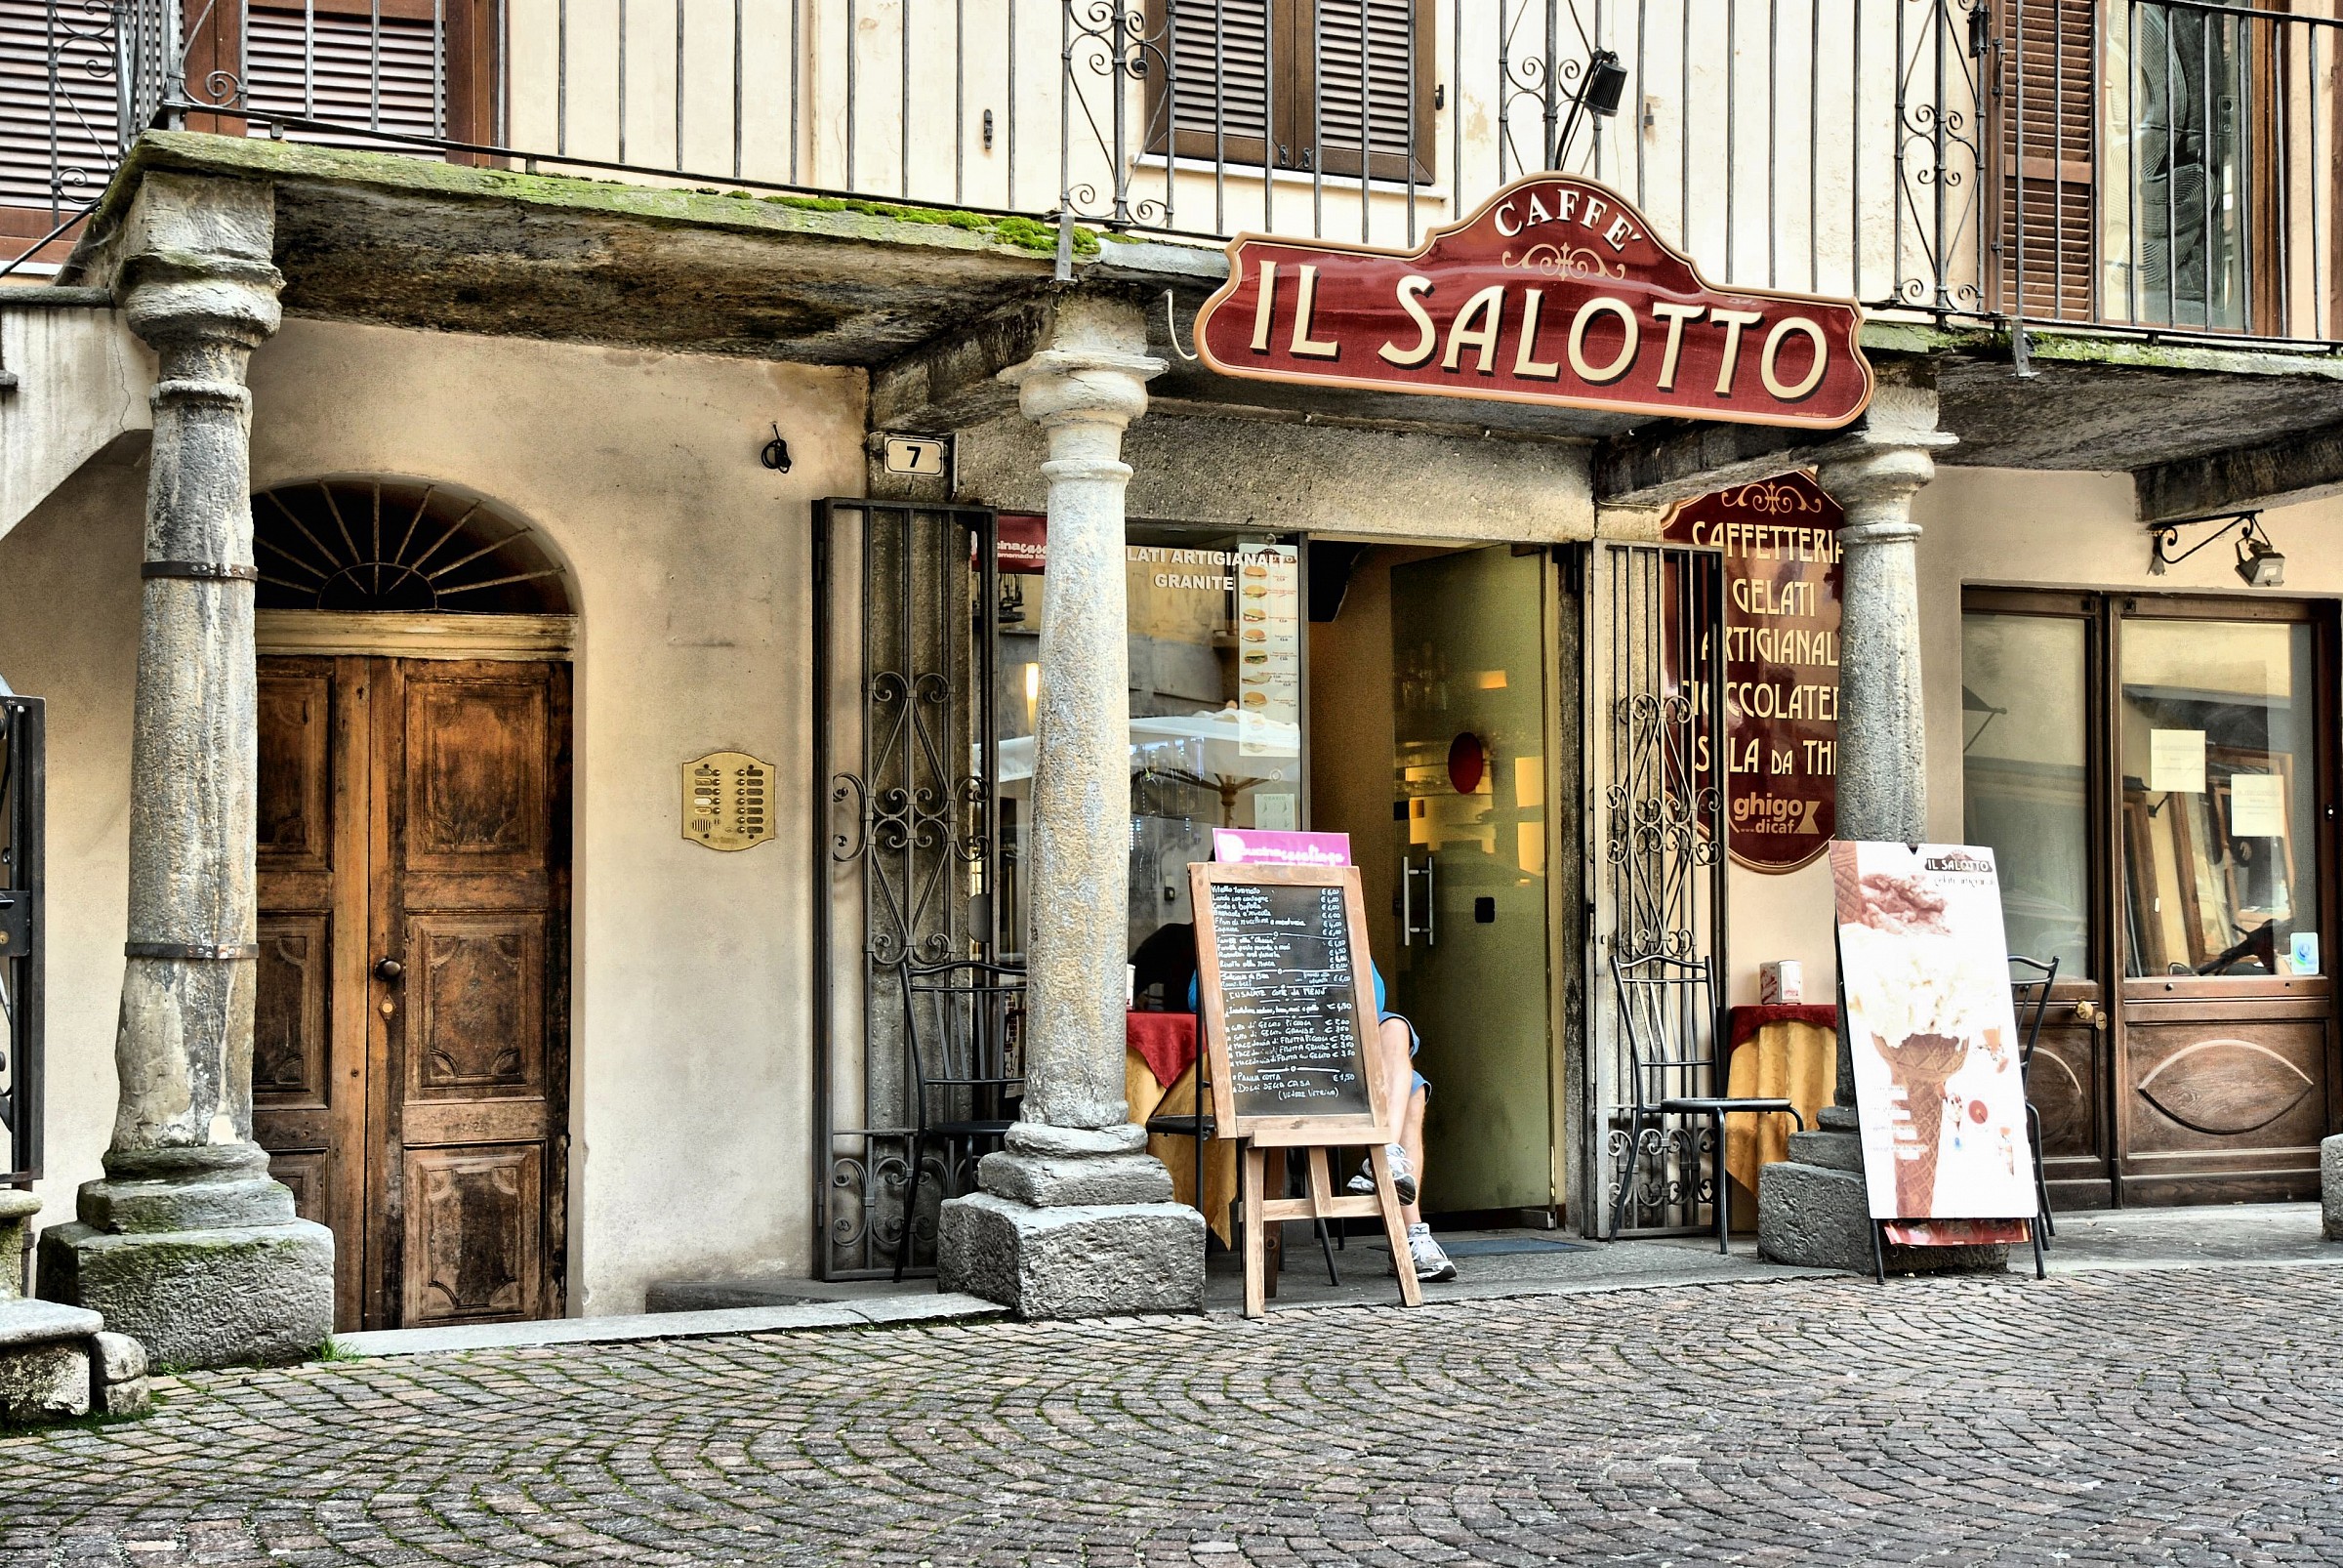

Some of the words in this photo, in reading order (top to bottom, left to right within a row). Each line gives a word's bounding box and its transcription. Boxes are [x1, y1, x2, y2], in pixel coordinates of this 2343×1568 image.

[1251, 260, 1338, 357] IL
[1377, 274, 1828, 398] SALOTTO
[907, 446, 921, 468] 7
[1172, 550, 1285, 568] ARTIGIANALI
[1154, 573, 1234, 591] GRANITE
[1732, 579, 1817, 617] GELATI
[1695, 736, 1759, 773] SLA
[1771, 750, 1793, 775] DA
[1733, 792, 1802, 822] ghigo
[1928, 859, 1938, 869] IL
[1941, 860, 1989, 871] SALOTTO
